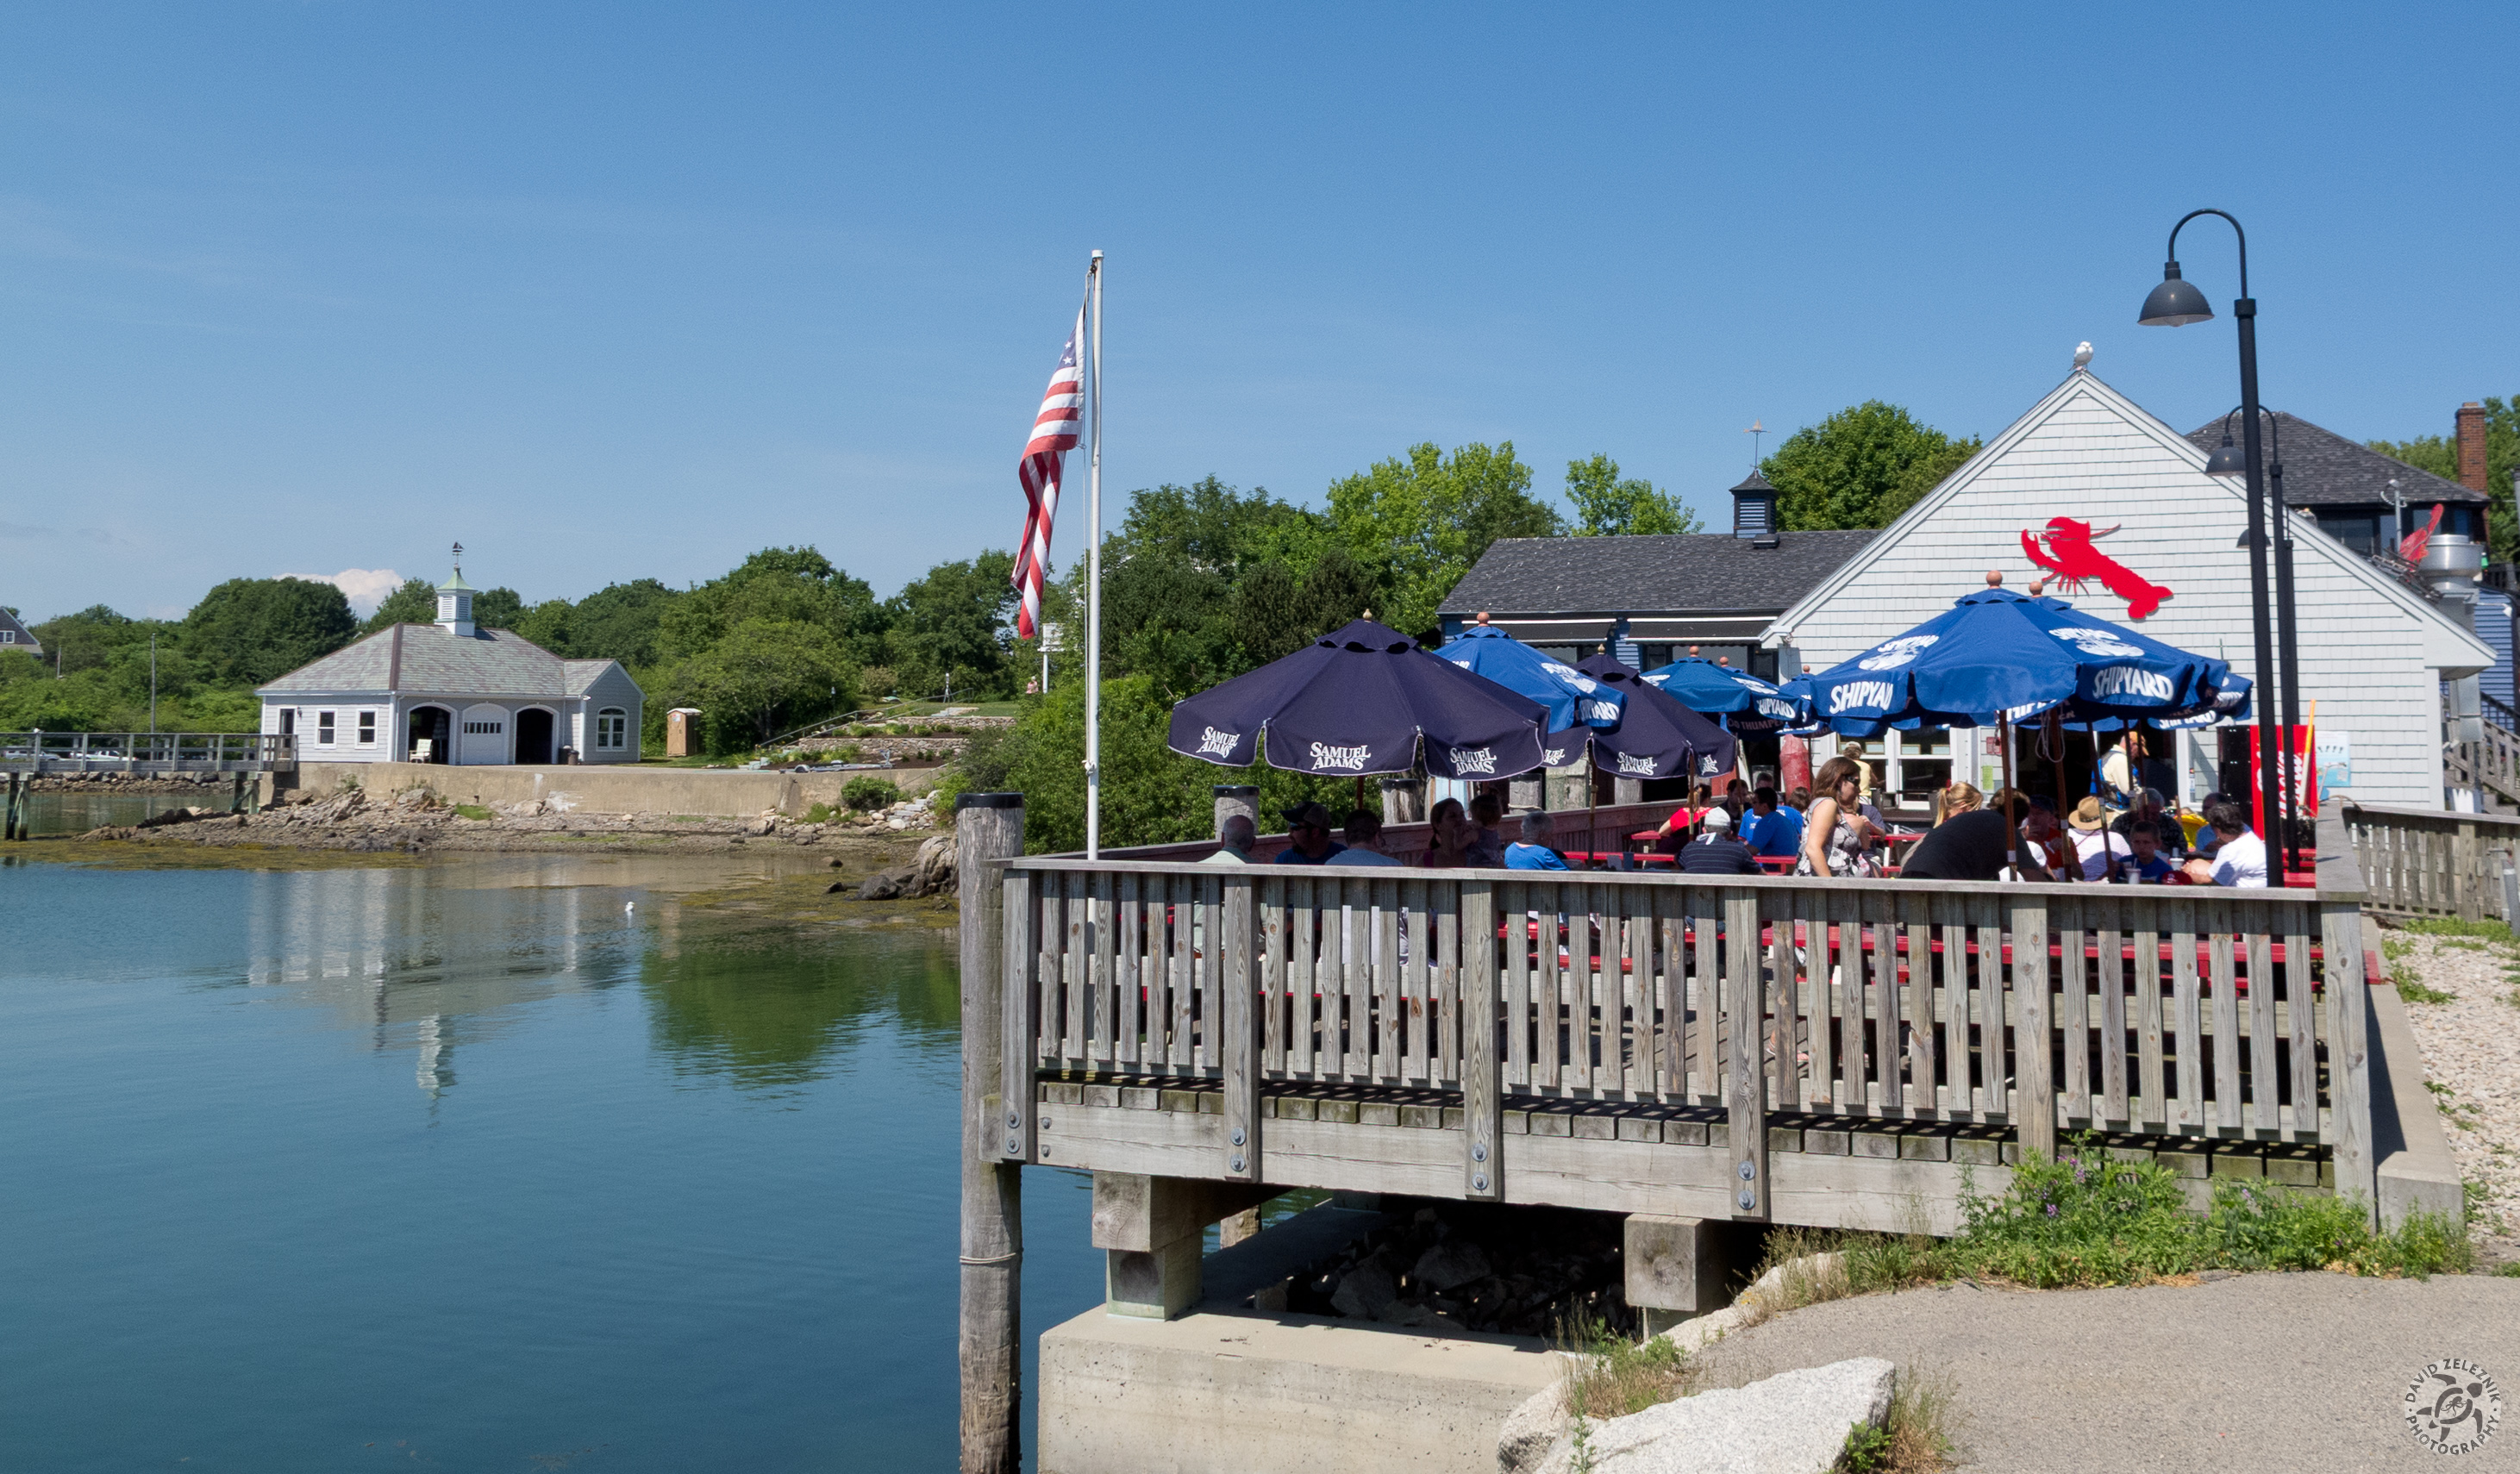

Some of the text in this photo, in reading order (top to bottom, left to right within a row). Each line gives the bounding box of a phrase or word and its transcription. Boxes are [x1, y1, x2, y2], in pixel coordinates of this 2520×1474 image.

[2092, 666, 2173, 701] SHIPYARD
[1202, 726, 1241, 746] SAMUEL
[1196, 741, 1233, 759] ADAMS
[1310, 741, 1371, 758] SAMUEL
[1450, 747, 1497, 763] SAMUEL
[1545, 748, 1565, 759] UEL
[1311, 756, 1366, 771] ADAMS
[1617, 752, 1657, 767] SAMUEL
[1456, 760, 1495, 776] ADAMS
[1619, 761, 1654, 776] ADAMS
